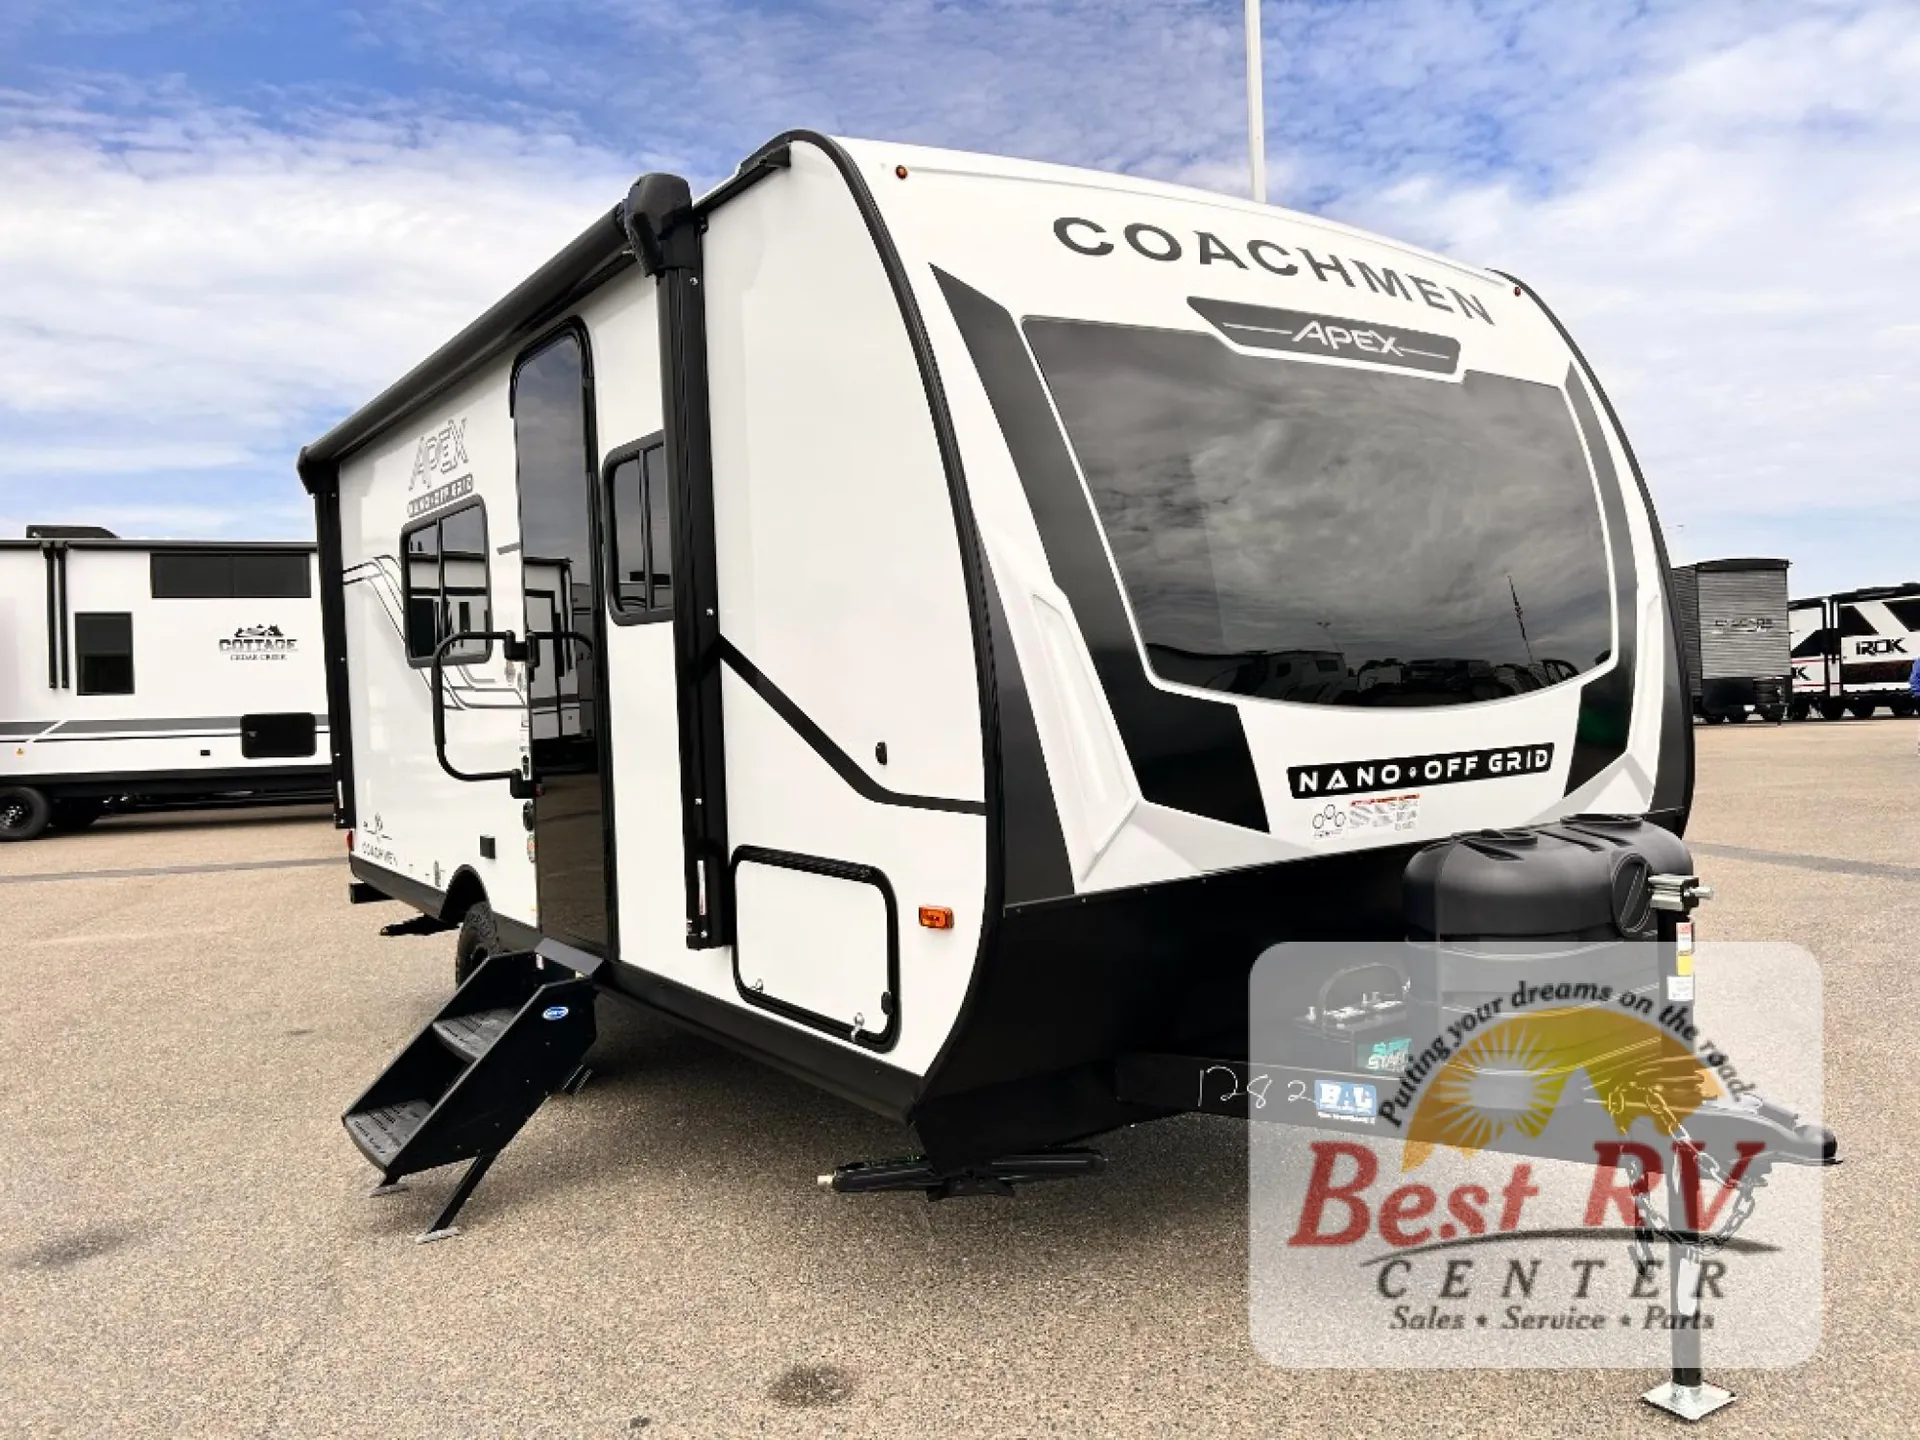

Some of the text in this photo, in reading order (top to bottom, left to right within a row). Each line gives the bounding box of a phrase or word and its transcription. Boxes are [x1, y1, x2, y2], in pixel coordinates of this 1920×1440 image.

[1053, 217, 1495, 326] COACHMEN
[1291, 320, 1405, 357] APEX
[219, 639, 298, 652] COTTAGE
[1299, 748, 1548, 792] NANO OFF GRID
[1197, 1065, 1319, 1109] 1282
